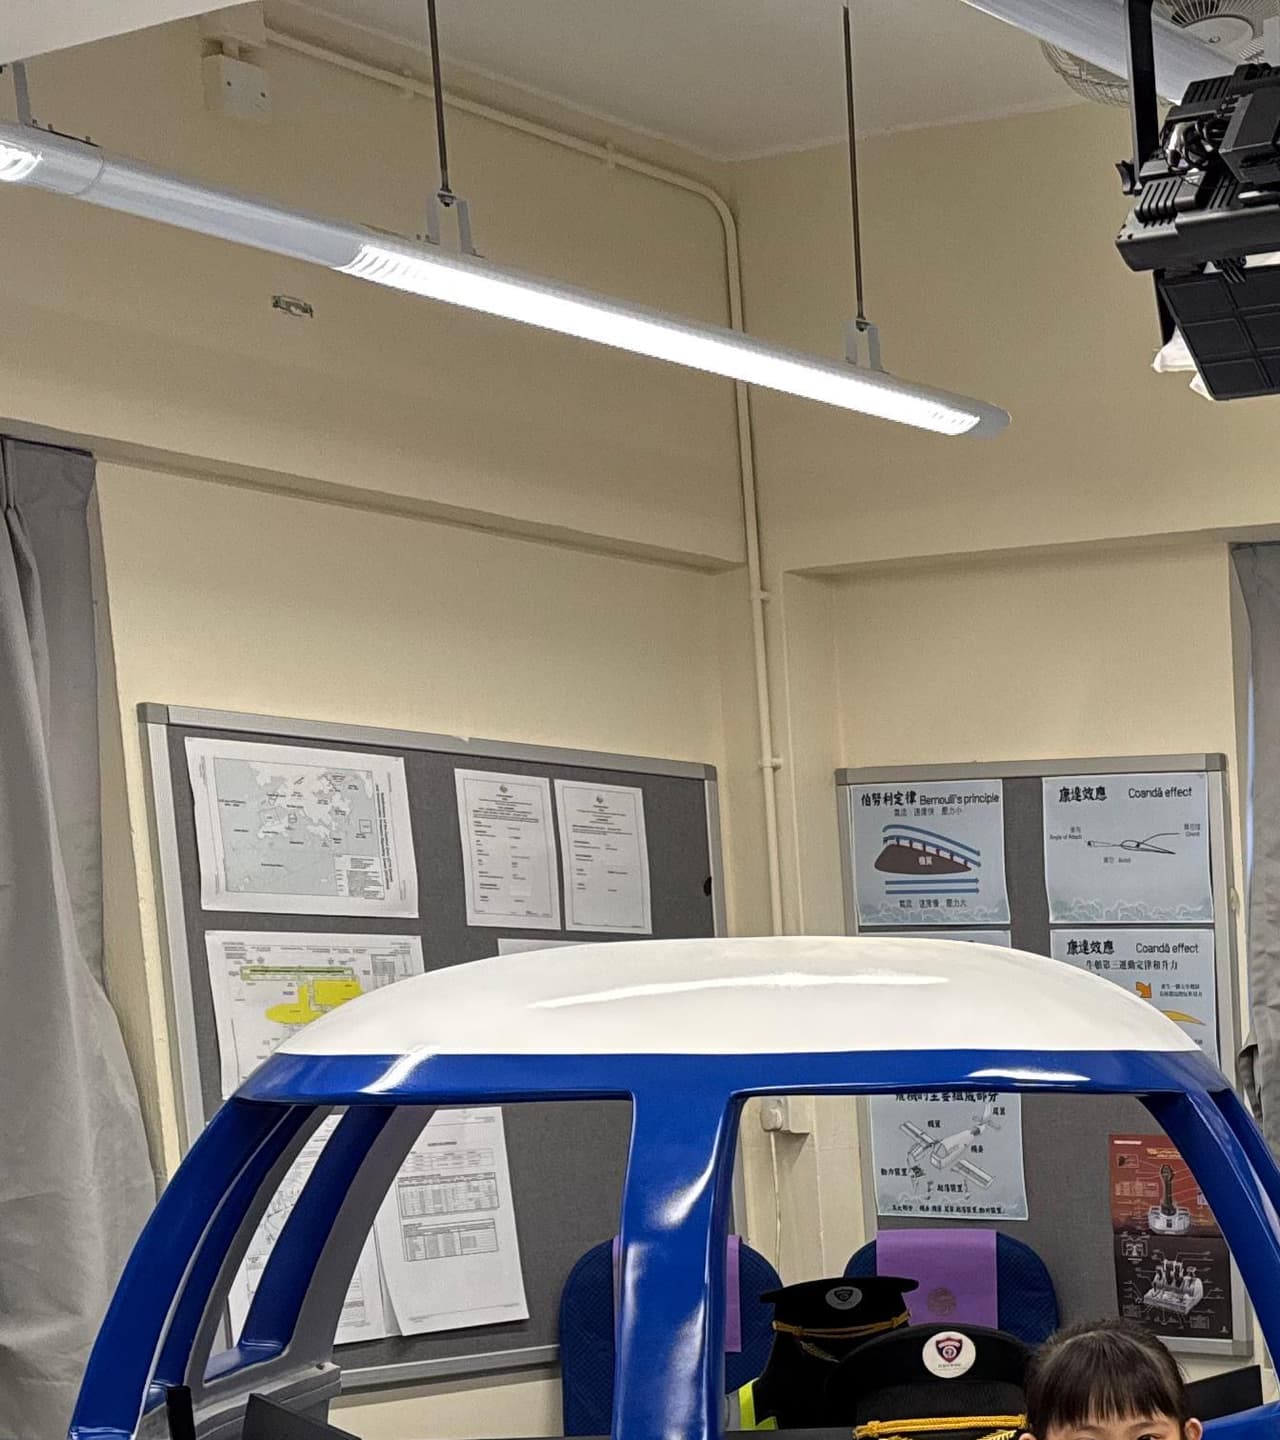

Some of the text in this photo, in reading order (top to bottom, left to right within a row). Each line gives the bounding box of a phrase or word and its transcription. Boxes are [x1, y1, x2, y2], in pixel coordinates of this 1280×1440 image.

[1164, 786, 1192, 798] effect
[964, 792, 999, 806] principle
[1172, 942, 1199, 954] effect
